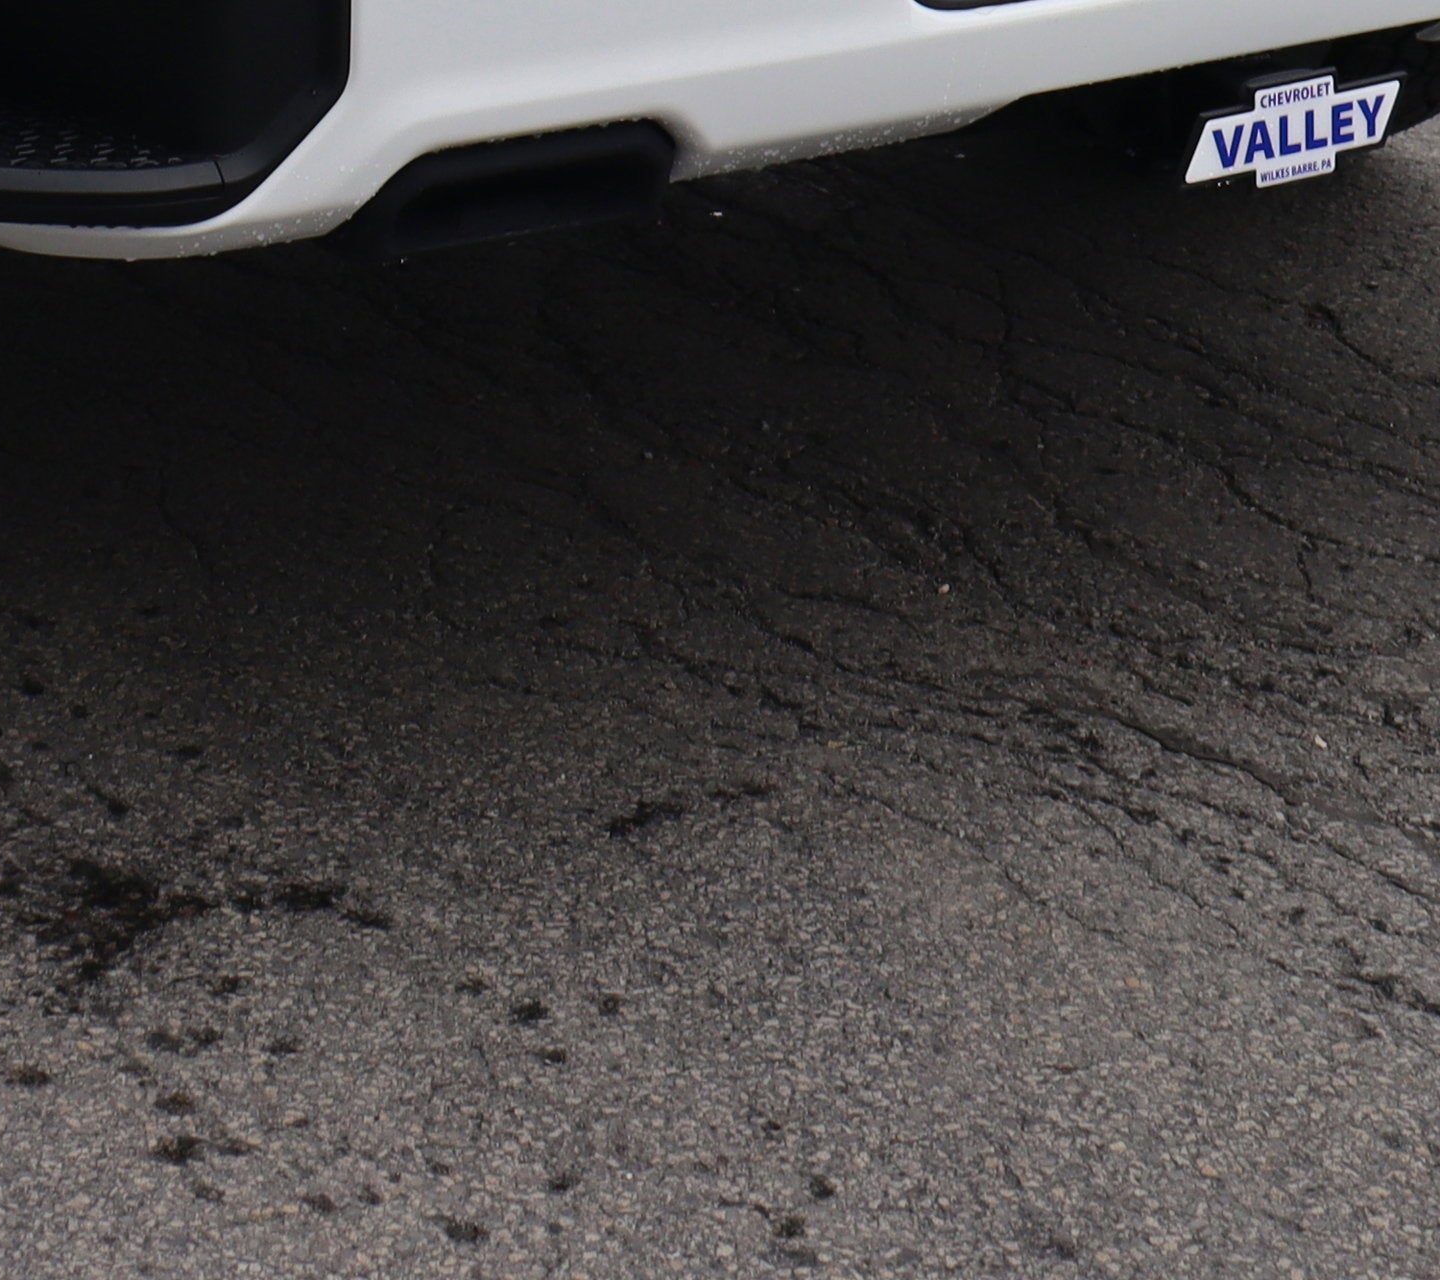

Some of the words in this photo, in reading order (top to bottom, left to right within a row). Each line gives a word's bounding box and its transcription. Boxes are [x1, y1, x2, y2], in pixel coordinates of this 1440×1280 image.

[1260, 82, 1331, 109] CHEVROLET
[1212, 94, 1386, 169] VALLEY
[1260, 167, 1290, 183] WILKES
[1321, 158, 1332, 170] PA
